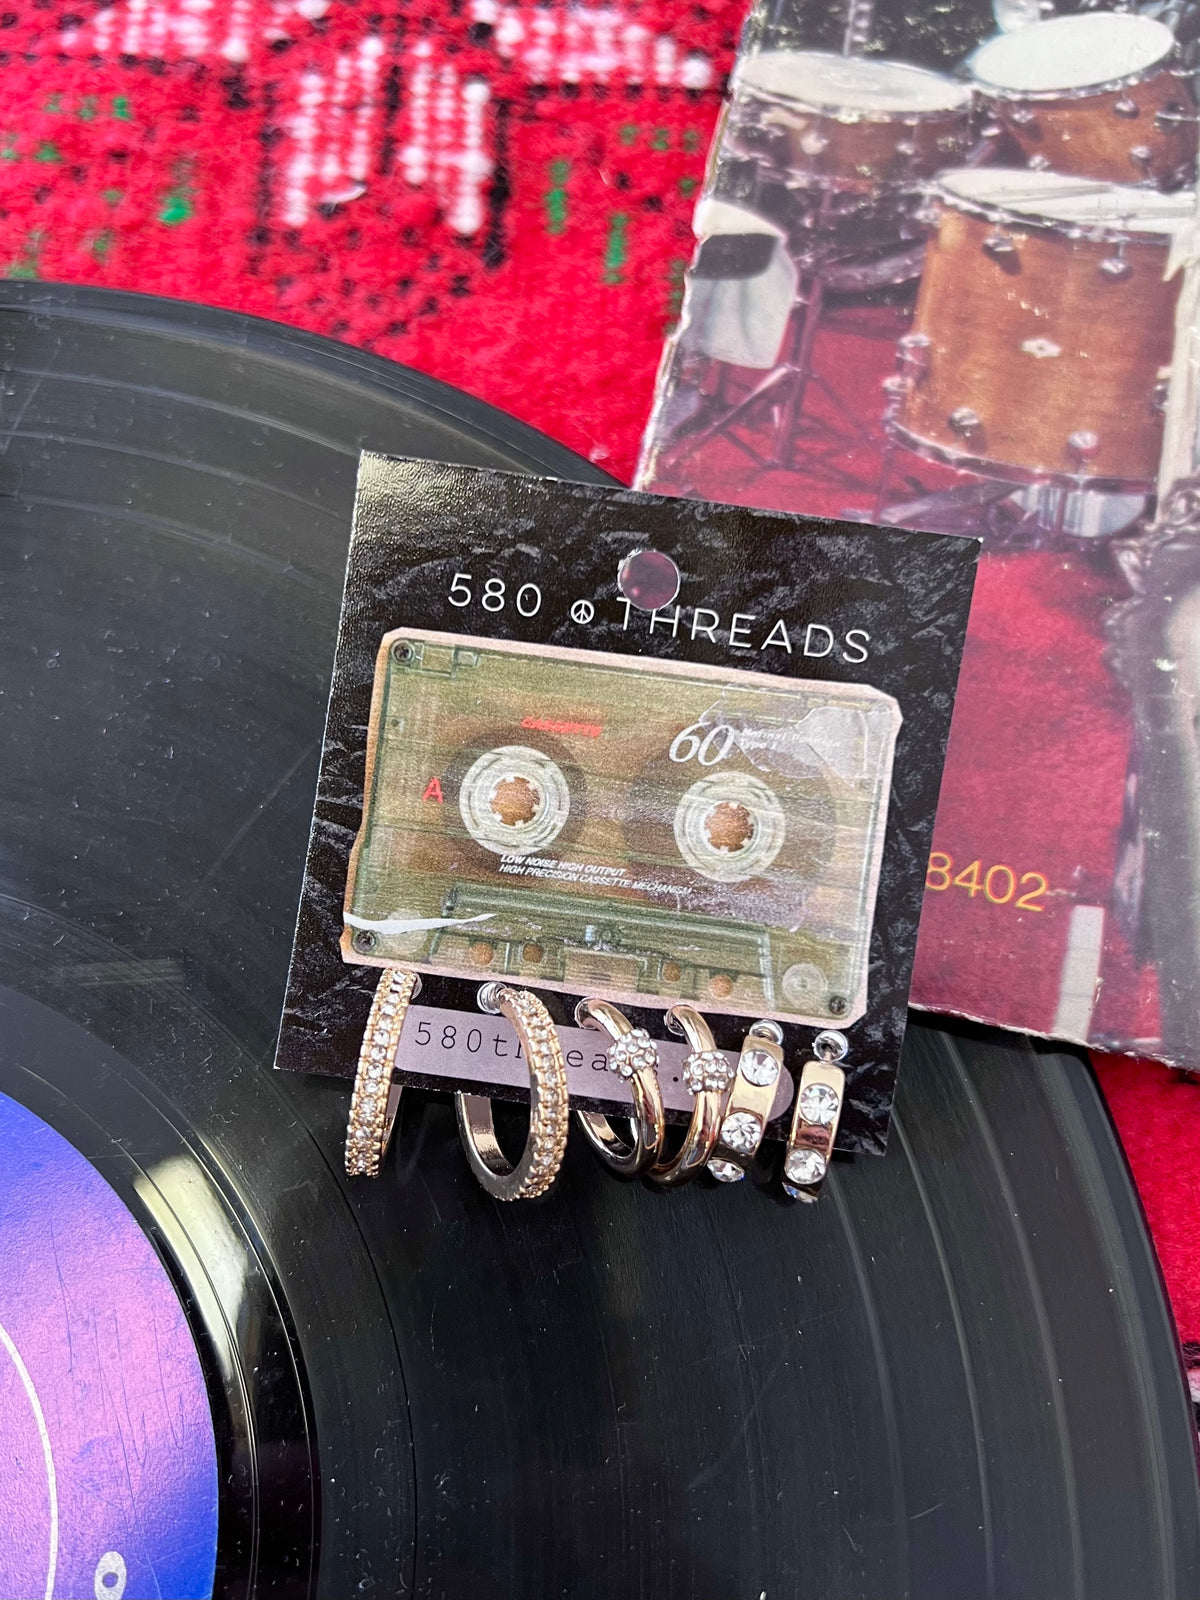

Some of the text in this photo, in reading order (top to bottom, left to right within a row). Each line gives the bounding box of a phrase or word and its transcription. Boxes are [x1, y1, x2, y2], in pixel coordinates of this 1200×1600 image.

[447, 572, 871, 664] 580 THREADS
[668, 721, 736, 766] 60
[422, 776, 444, 805] A
[499, 863, 693, 896] HIGH PRECISION CASSETTE MECHANISM
[500, 854, 627, 877] LOW NOISE HIGH OUTPUT
[926, 851, 1049, 913] 8402
